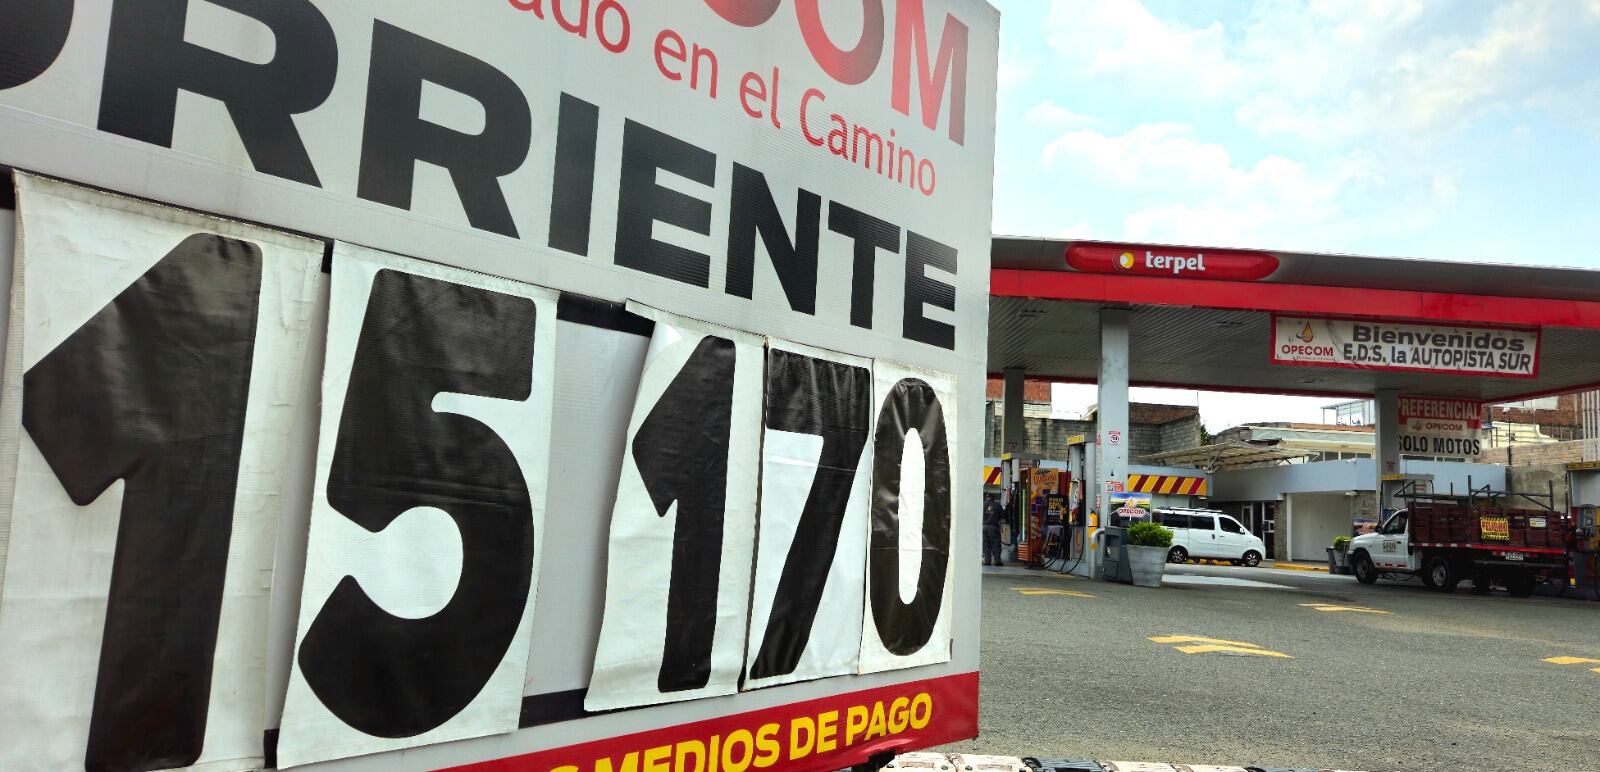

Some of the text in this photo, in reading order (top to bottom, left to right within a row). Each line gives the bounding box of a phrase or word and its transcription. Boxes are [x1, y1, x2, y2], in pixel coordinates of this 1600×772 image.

[654, 29, 719, 99] en
[739, 66, 781, 129] el
[800, 88, 936, 196] Camino
[0, 0, 958, 350] RRIENTE
[1145, 251, 1205, 274] terpel
[1353, 325, 1525, 351] Bienvenidos
[1281, 344, 1334, 357] OPECOM
[1391, 346, 1407, 364] la
[1411, 347, 1495, 369] AUTOPISTA
[1498, 352, 1532, 372] SUR
[1399, 399, 1479, 420] REFERENCIAL
[1425, 422, 1463, 432] OPECOM
[1433, 437, 1480, 456] MOTOS
[789, 709, 838, 759] DE
[845, 692, 933, 748] PAGO
